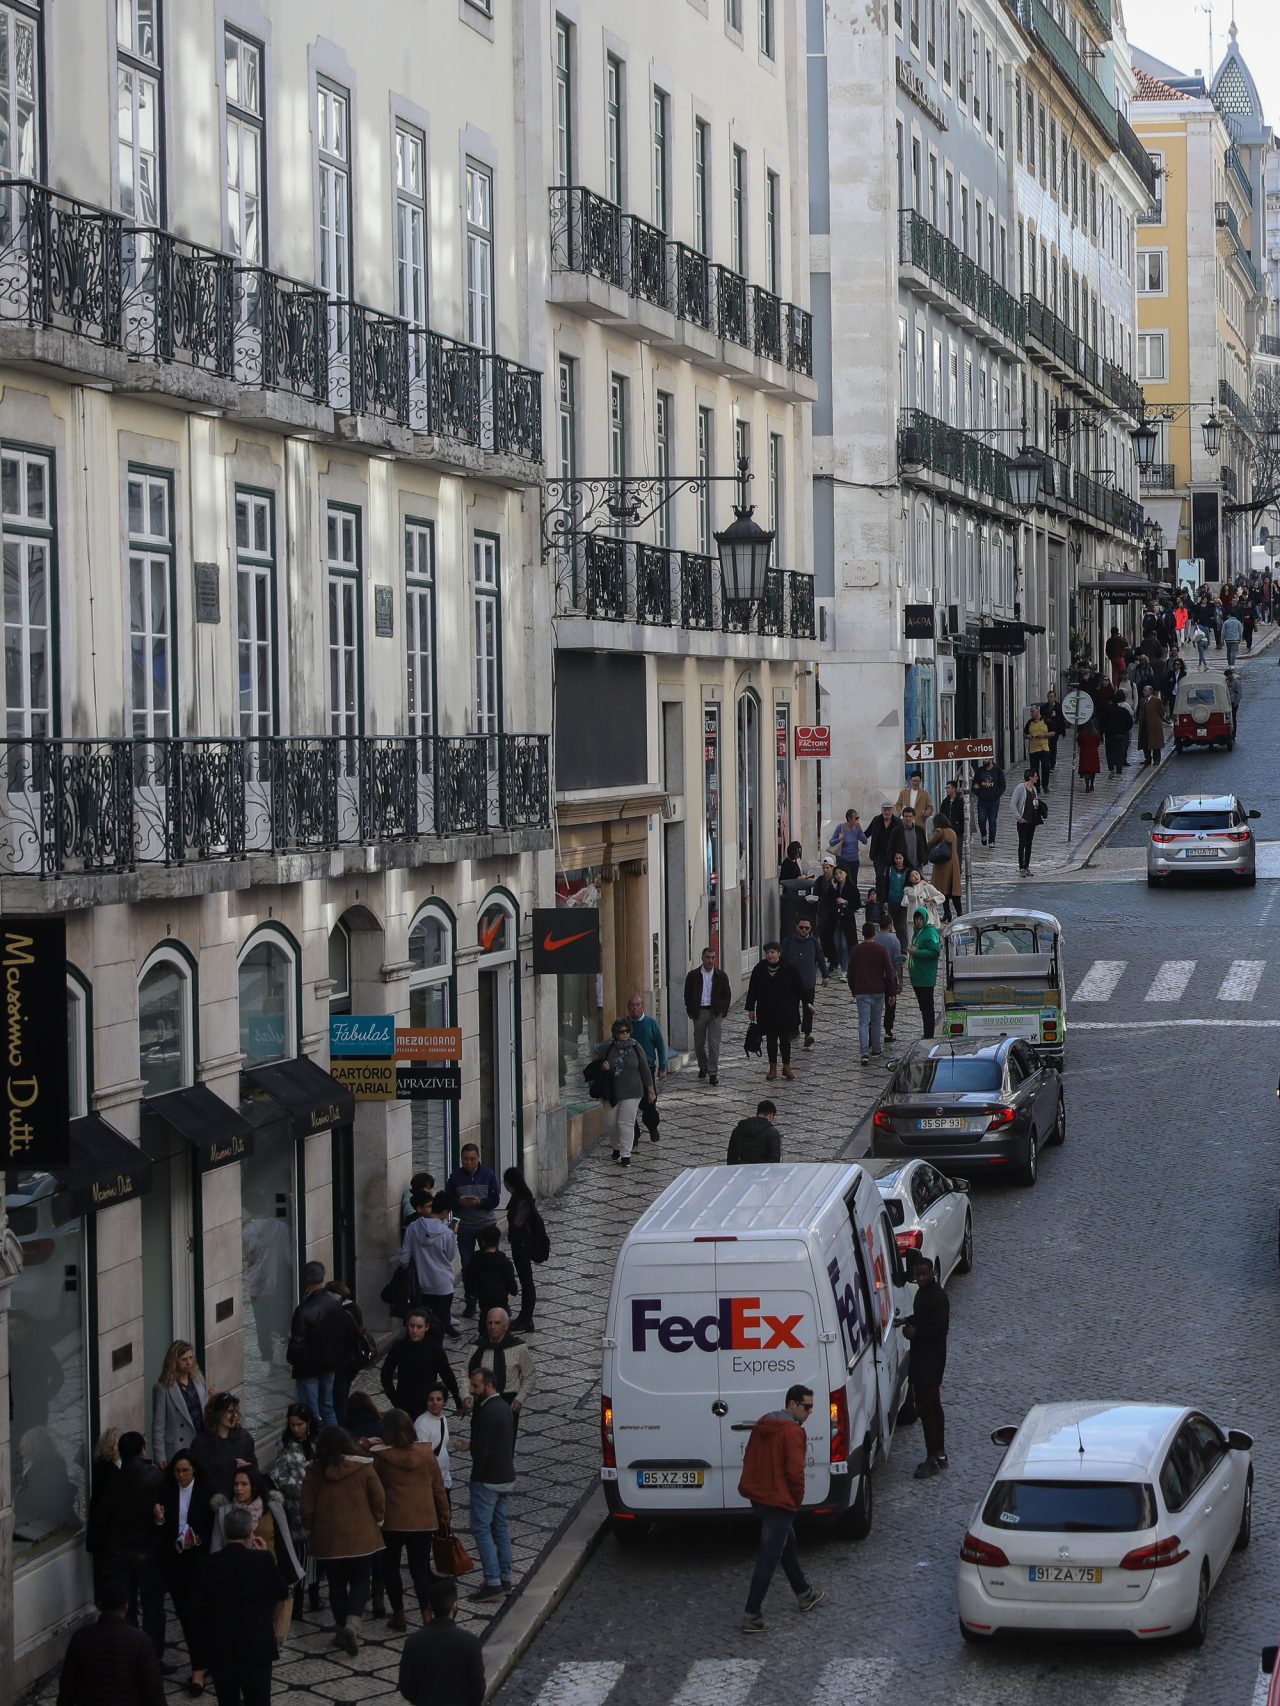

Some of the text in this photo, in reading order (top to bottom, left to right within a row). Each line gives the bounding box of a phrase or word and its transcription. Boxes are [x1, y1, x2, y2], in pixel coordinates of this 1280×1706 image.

[331, 1023, 391, 1042] Fábulas
[2, 932, 38, 1157] Massimo Dutti
[331, 1065, 392, 1080] CARTÓRIO
[396, 1077, 458, 1089] APRAZÍVEL
[631, 1297, 806, 1352] FedEx
[732, 1356, 795, 1376] Express
